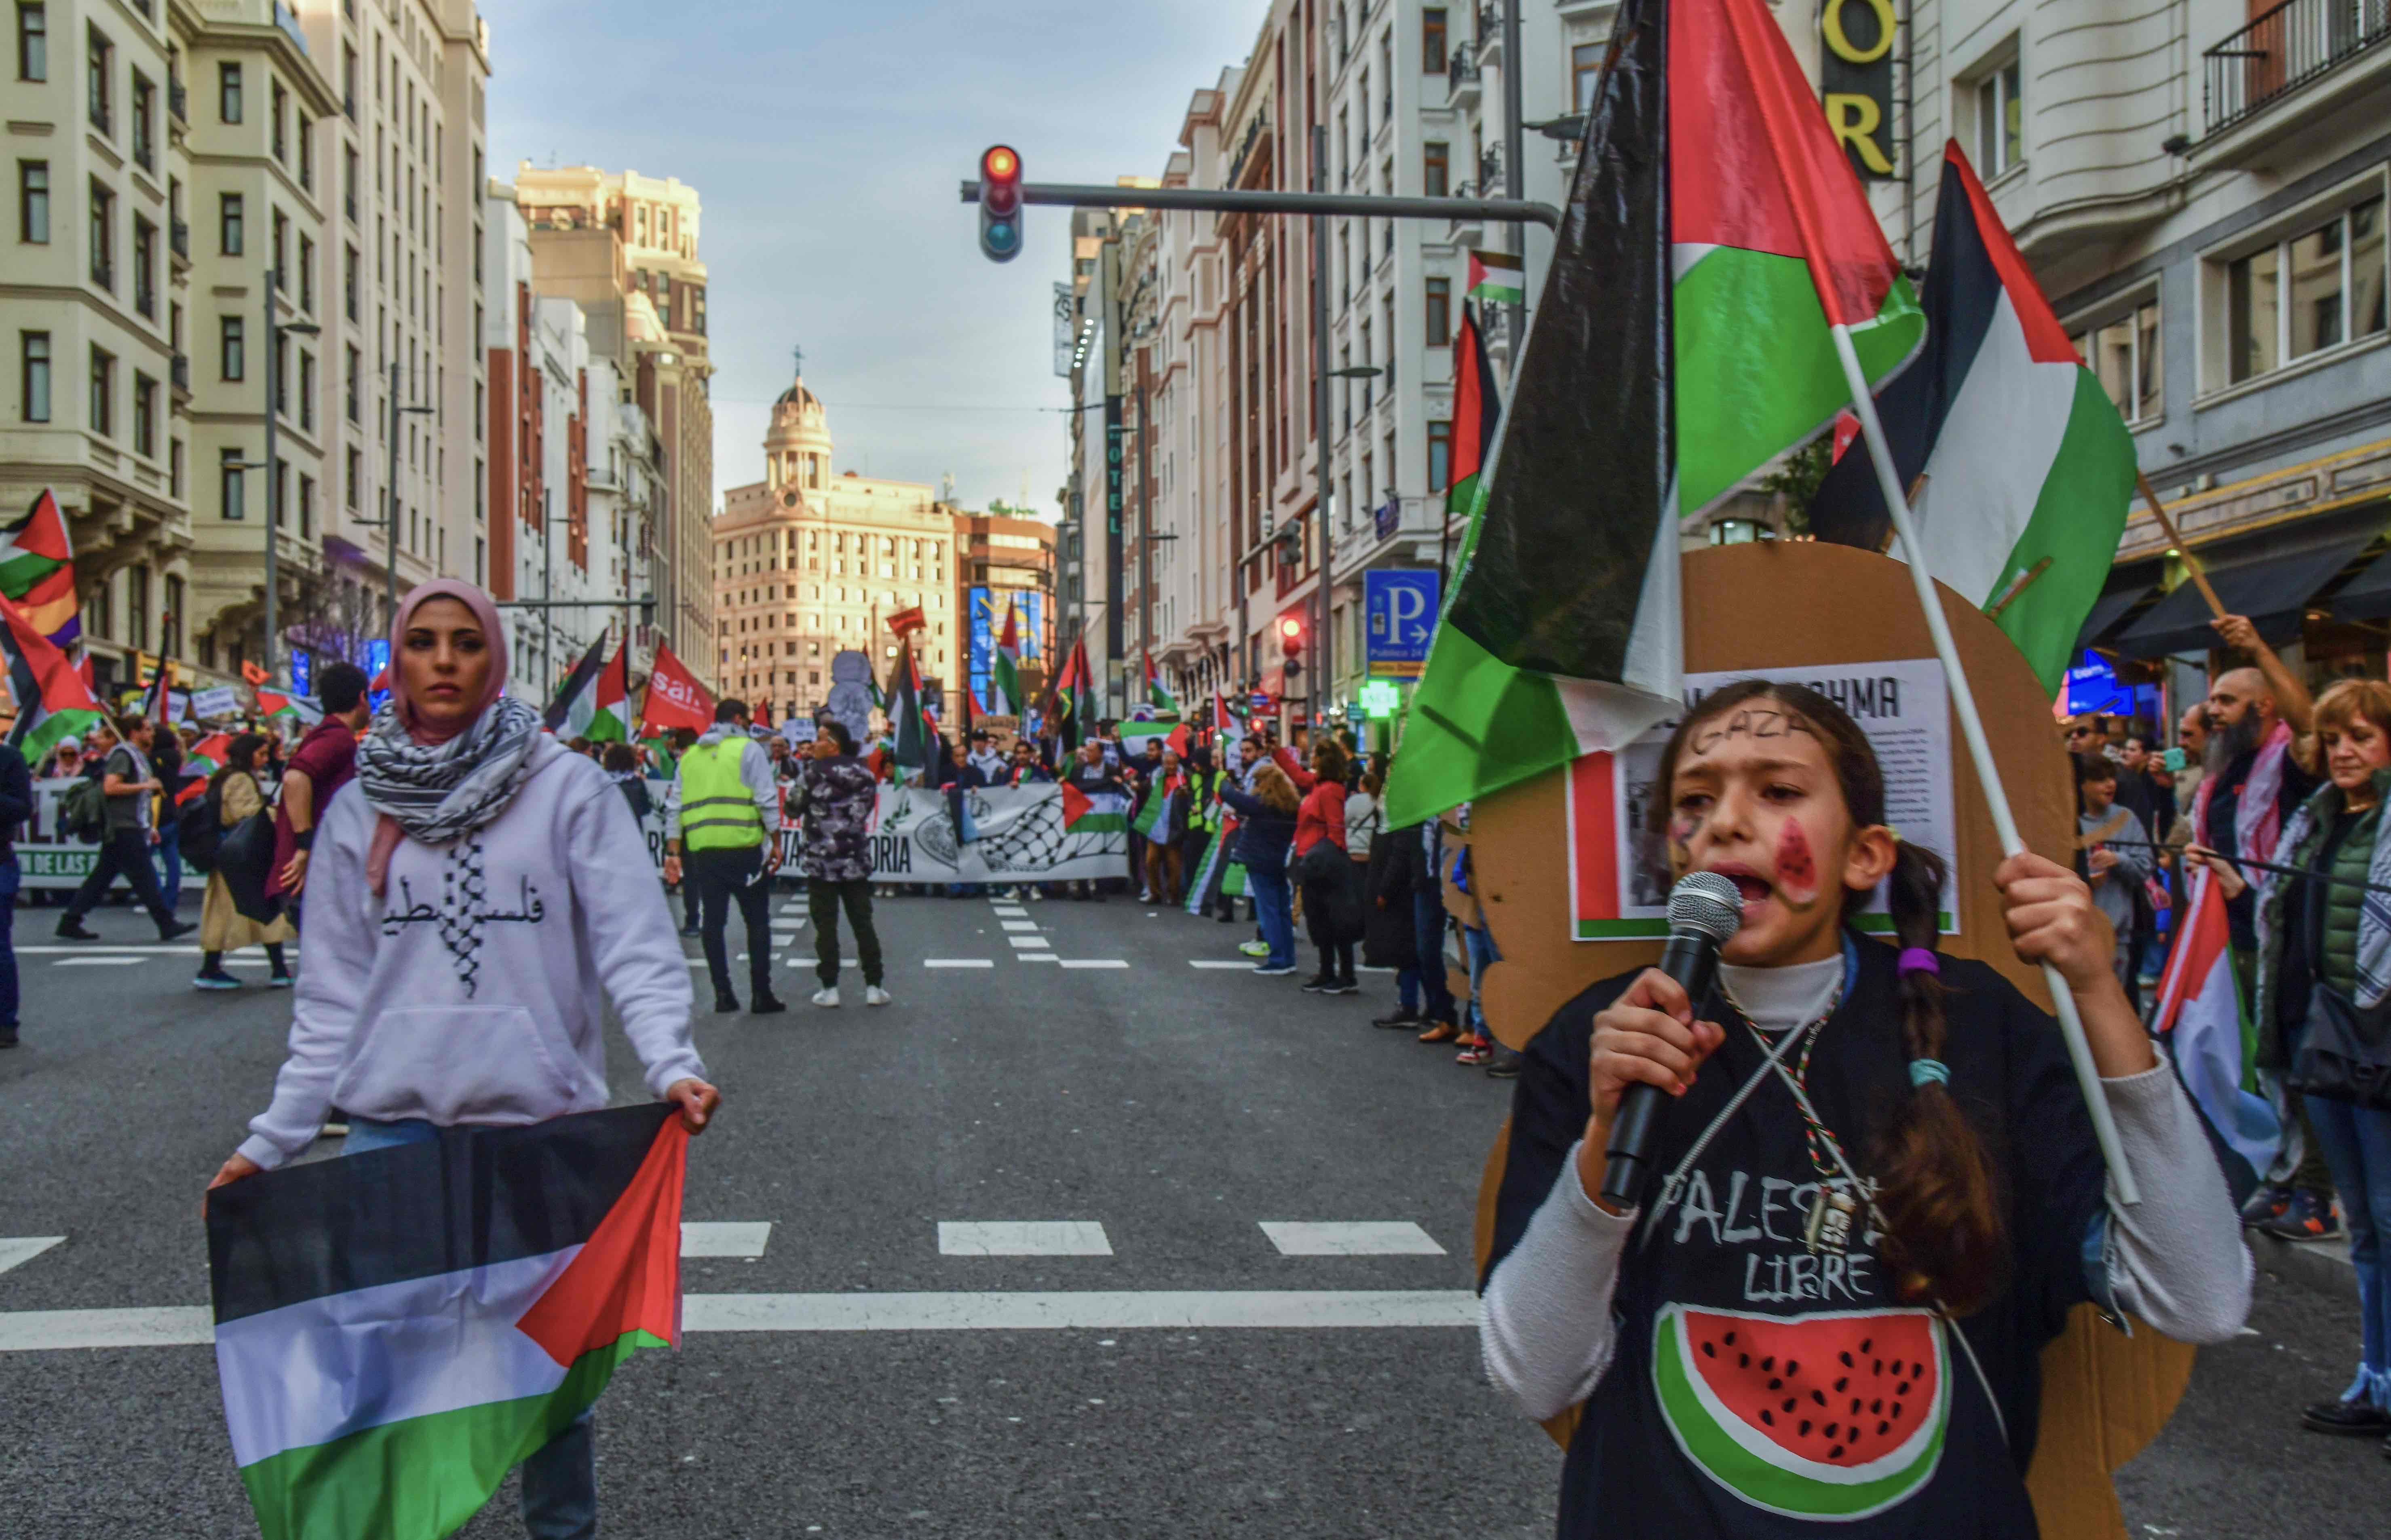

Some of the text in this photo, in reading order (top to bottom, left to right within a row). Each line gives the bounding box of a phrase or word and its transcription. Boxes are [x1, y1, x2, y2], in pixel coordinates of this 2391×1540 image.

[1383, 587, 1425, 645] P
[1809, 677, 1899, 719] HMA
[34, 853, 53, 873] DE
[56, 853, 86, 873] LAS
[1744, 1252, 1874, 1302] LIBRE
